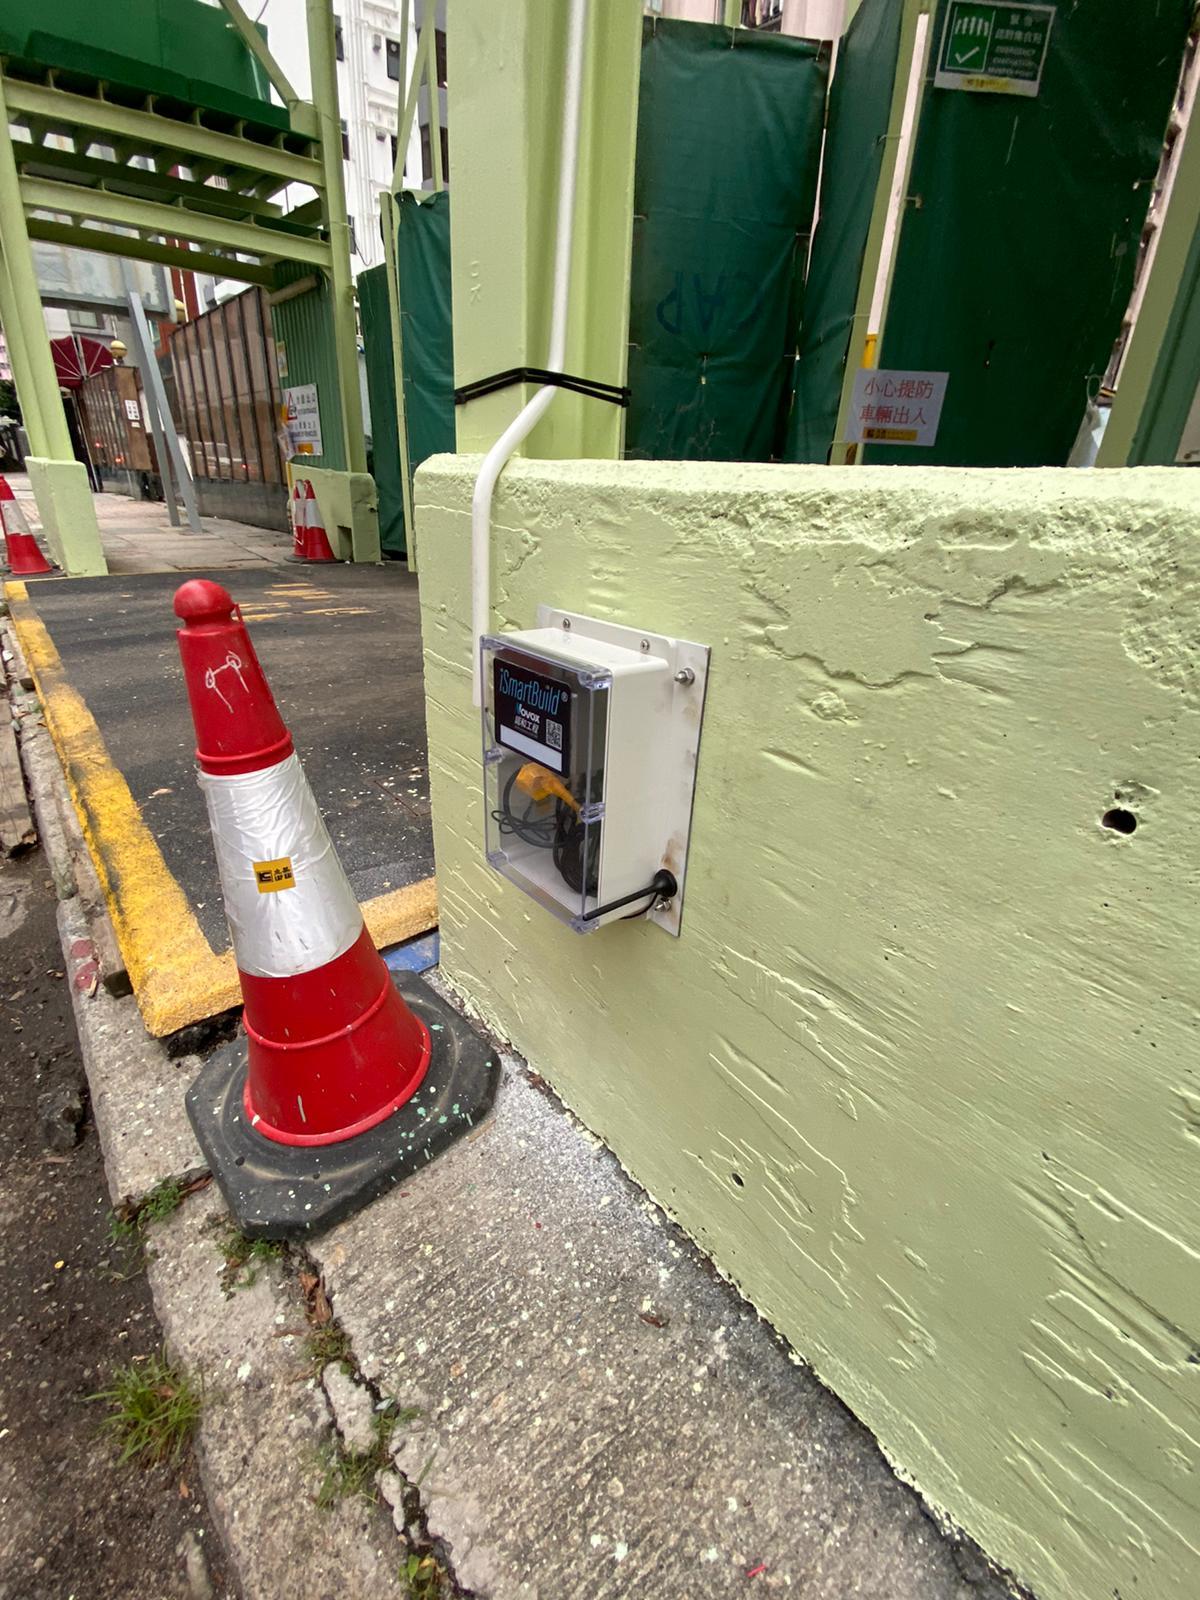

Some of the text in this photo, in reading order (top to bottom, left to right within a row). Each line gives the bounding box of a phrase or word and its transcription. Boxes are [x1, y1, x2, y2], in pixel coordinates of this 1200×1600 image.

[864, 377, 934, 400] 小心提防
[859, 403, 927, 425] 車輛出入
